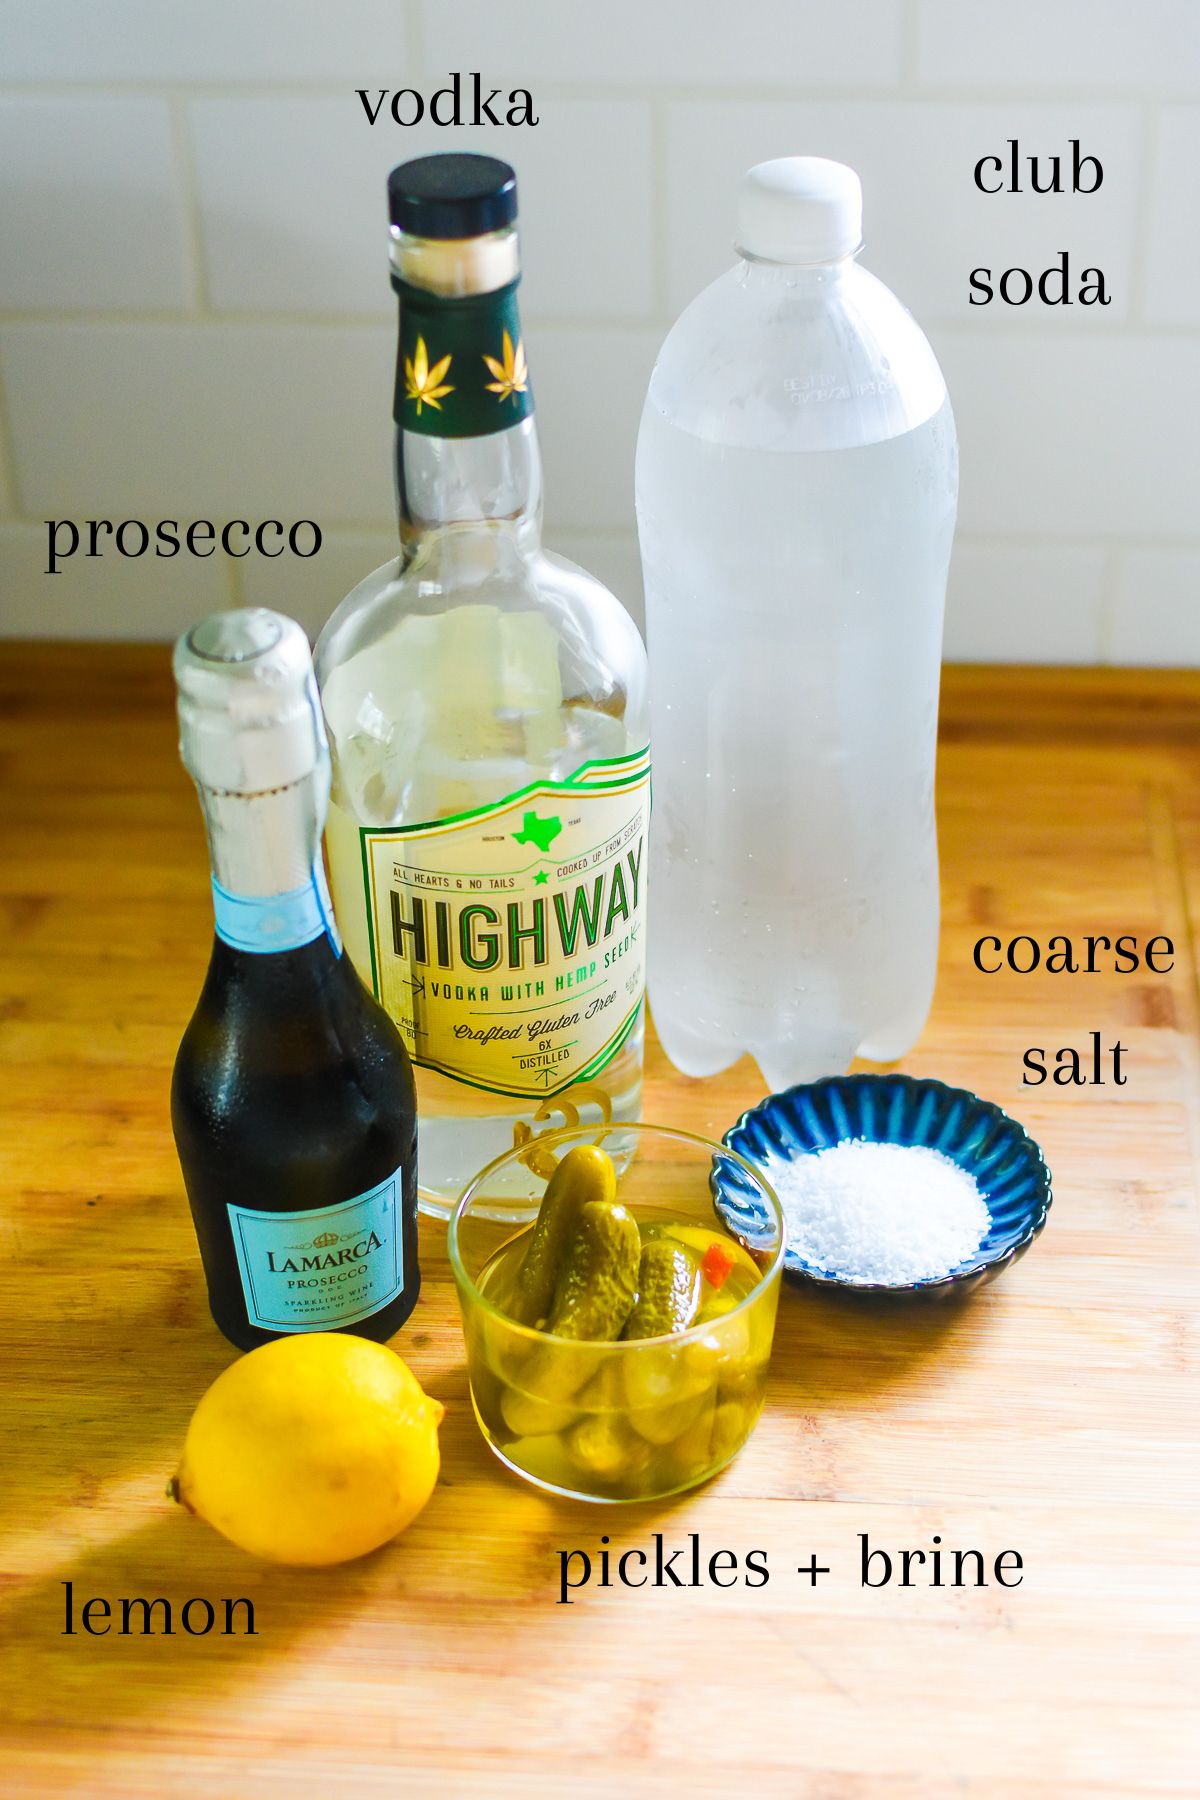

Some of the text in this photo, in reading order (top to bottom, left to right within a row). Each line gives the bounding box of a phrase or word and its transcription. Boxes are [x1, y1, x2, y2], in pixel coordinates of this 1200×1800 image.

[557, 858, 588, 878] COOKED
[592, 850, 602, 863] UP
[605, 838, 621, 856] FROM
[393, 867, 515, 889] ALL HEARTS & NO TAILS
[390, 835, 643, 970] HIGHWAY
[431, 981, 489, 1001] VODKA
[501, 980, 544, 1001] WITH
[556, 961, 597, 992] HEMP
[604, 936, 631, 969] SEED
[453, 990, 617, 1046] Crafted Gluten Free
[538, 1039, 552, 1051] 6X
[520, 1049, 570, 1070] DISTILLED
[287, 1264, 369, 1289] PROSECCO
[284, 1281, 375, 1306] SPARKLING WINE
